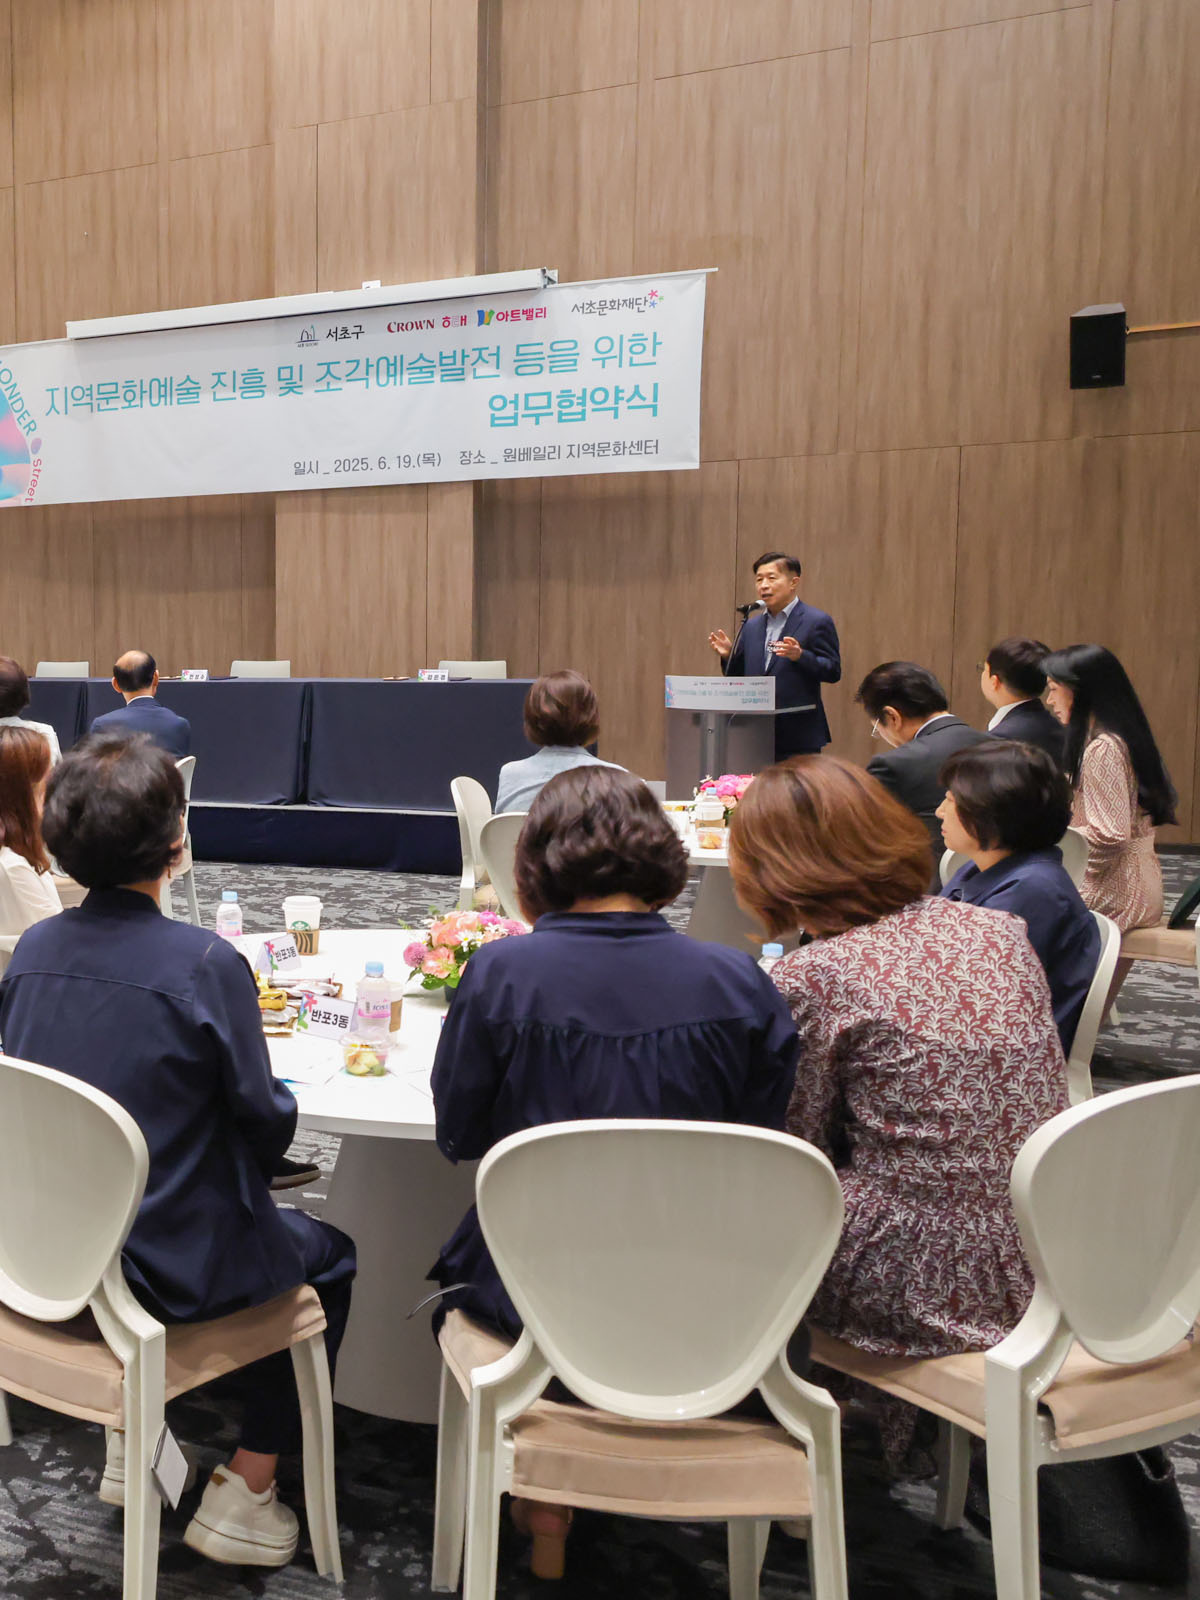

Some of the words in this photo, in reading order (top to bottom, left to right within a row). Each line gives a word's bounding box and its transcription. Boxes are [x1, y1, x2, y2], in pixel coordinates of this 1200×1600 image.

[495, 306, 547, 322] 아트밸리
[571, 296, 648, 316] 서초문화재단
[326, 325, 365, 342] 서초구
[387, 318, 435, 333] CROWN
[44, 374, 202, 416] 지역문화예술
[210, 367, 267, 403] 진흥
[277, 363, 304, 397] 및
[314, 344, 502, 394] 조각예술발전
[513, 337, 580, 377] 등을
[591, 330, 663, 369] 위한
[488, 381, 660, 428] 업무협약식
[459, 449, 487, 466] 장소
[503, 444, 561, 463] 원베일리
[565, 439, 660, 460] 지역문화센터
[293, 460, 320, 476] 일시
[334, 457, 373, 474] 2025.
[377, 456, 391, 471] 6.
[396, 453, 442, 469] 19.(목)
[25, 458, 42, 503] Street
[311, 1008, 350, 1029] 반포3동
